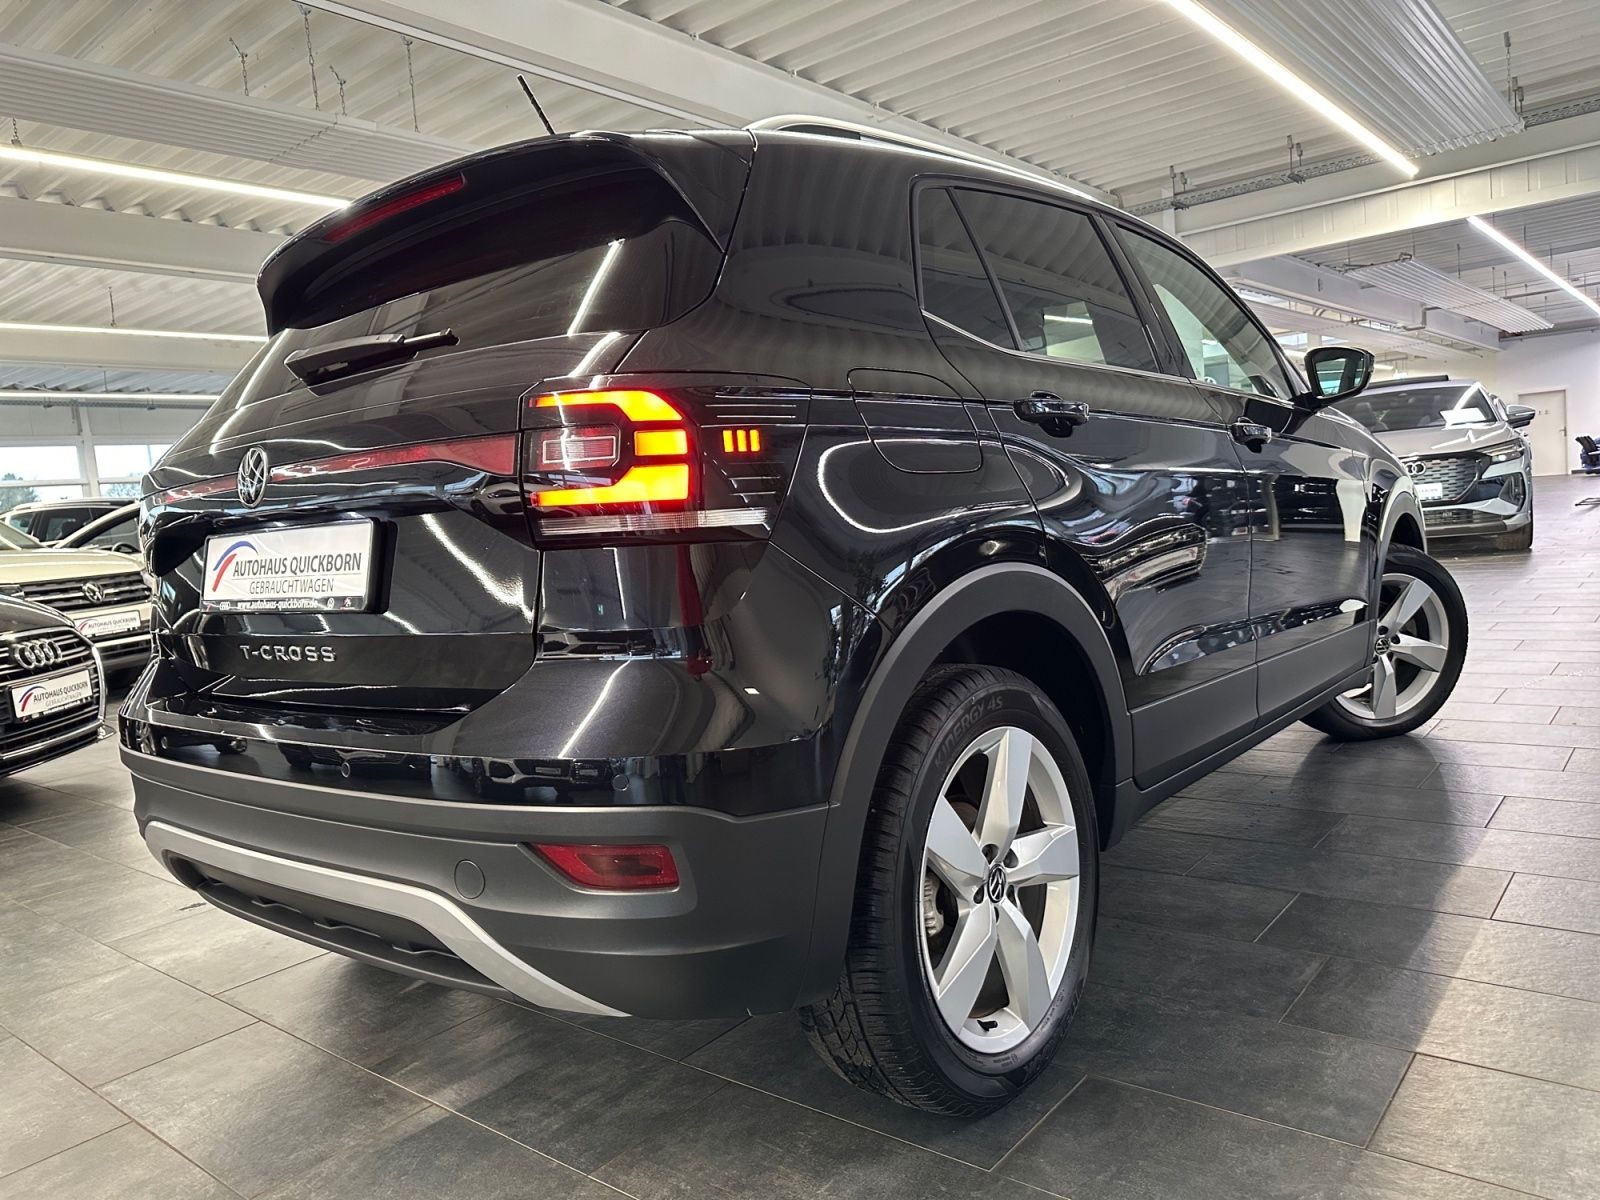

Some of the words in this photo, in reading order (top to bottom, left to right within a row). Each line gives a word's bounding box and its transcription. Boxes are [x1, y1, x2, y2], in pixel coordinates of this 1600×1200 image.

[233, 557, 288, 577] AUTOHAUS
[290, 552, 362, 574] QUICKBORN
[249, 578, 334, 595] GEBRAUCHTWAGEN
[240, 645, 336, 662] T-CROSS
[33, 688, 63, 702] AUTOHAUS
[63, 681, 88, 694] QUICKBORN
